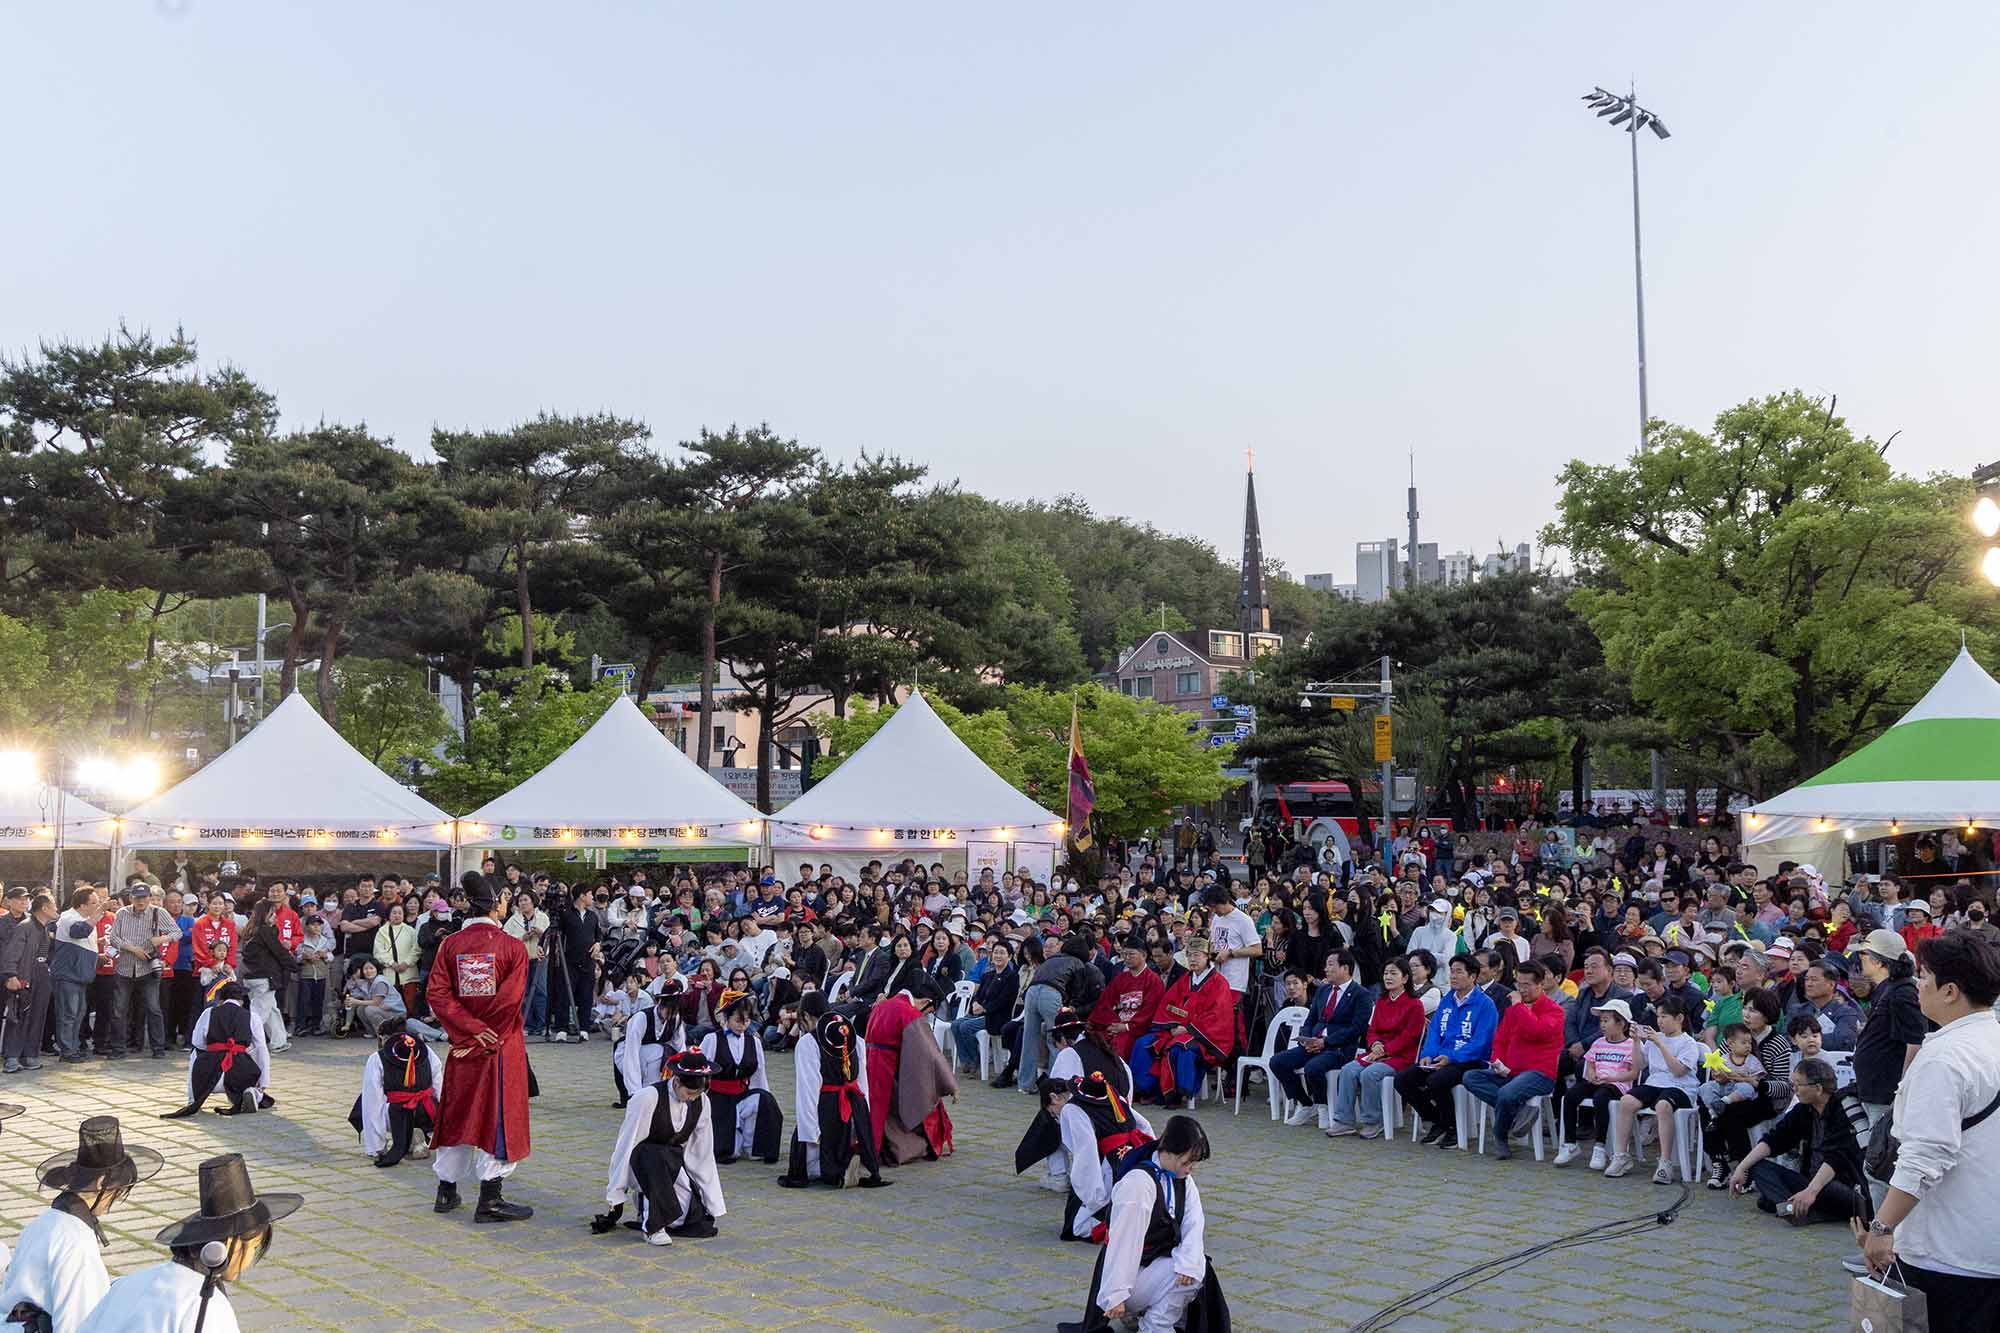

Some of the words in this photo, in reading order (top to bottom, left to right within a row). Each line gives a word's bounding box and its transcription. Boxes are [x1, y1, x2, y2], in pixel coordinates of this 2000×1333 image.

[283, 919, 291, 928] 2
[104, 924, 112, 934] 2
[221, 927, 229, 935] 2
